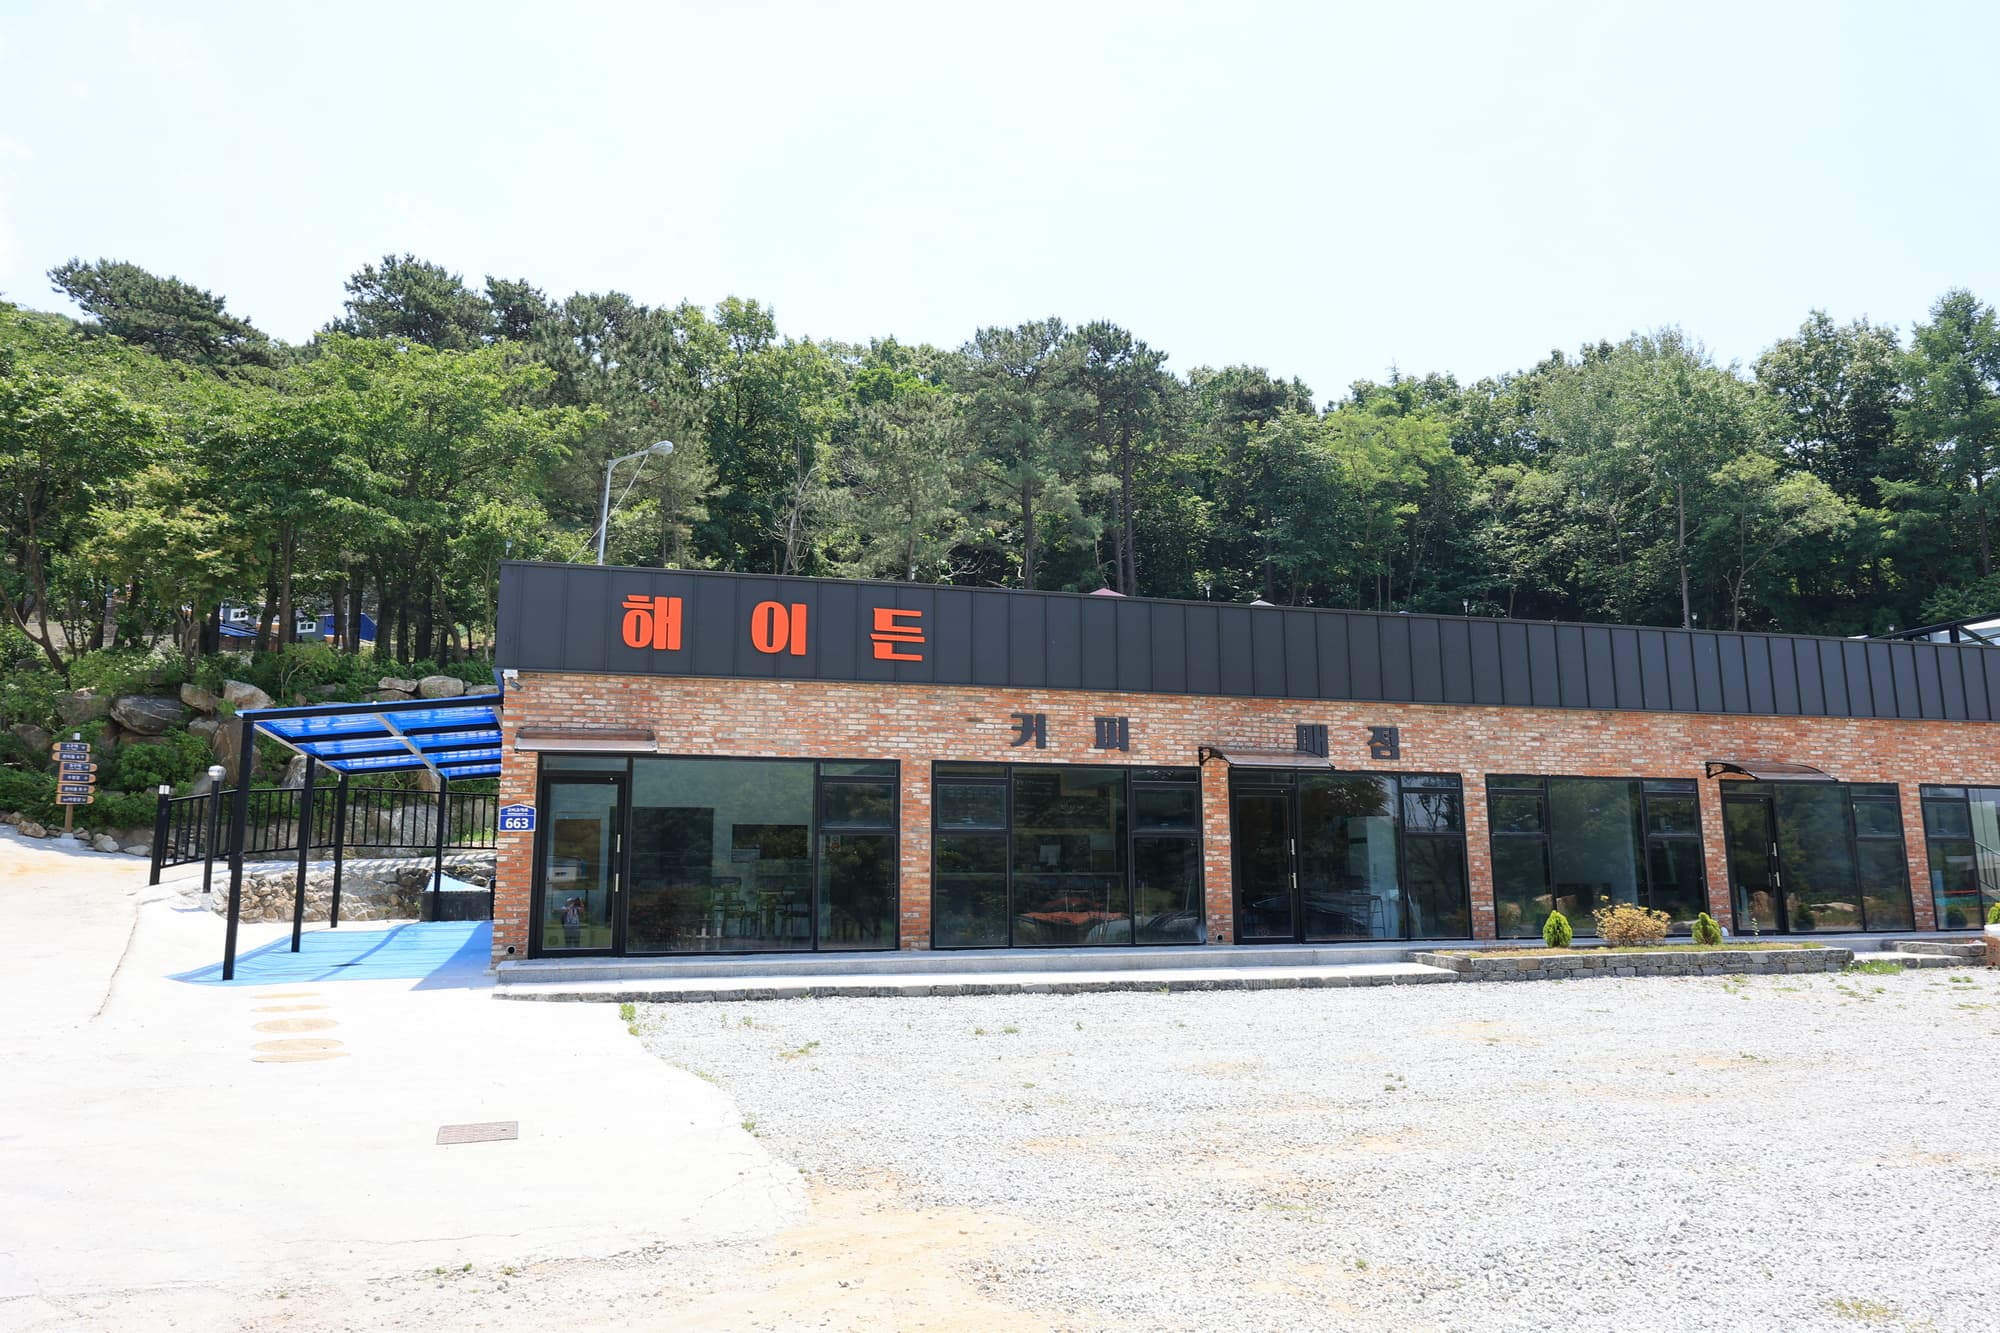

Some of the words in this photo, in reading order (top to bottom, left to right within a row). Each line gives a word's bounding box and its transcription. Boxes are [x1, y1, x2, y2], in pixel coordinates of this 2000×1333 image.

[622, 595, 925, 661] 해이든
[1011, 714, 1130, 752] 커피
[1295, 724, 1400, 760] 매점
[505, 817, 529, 829] 663
